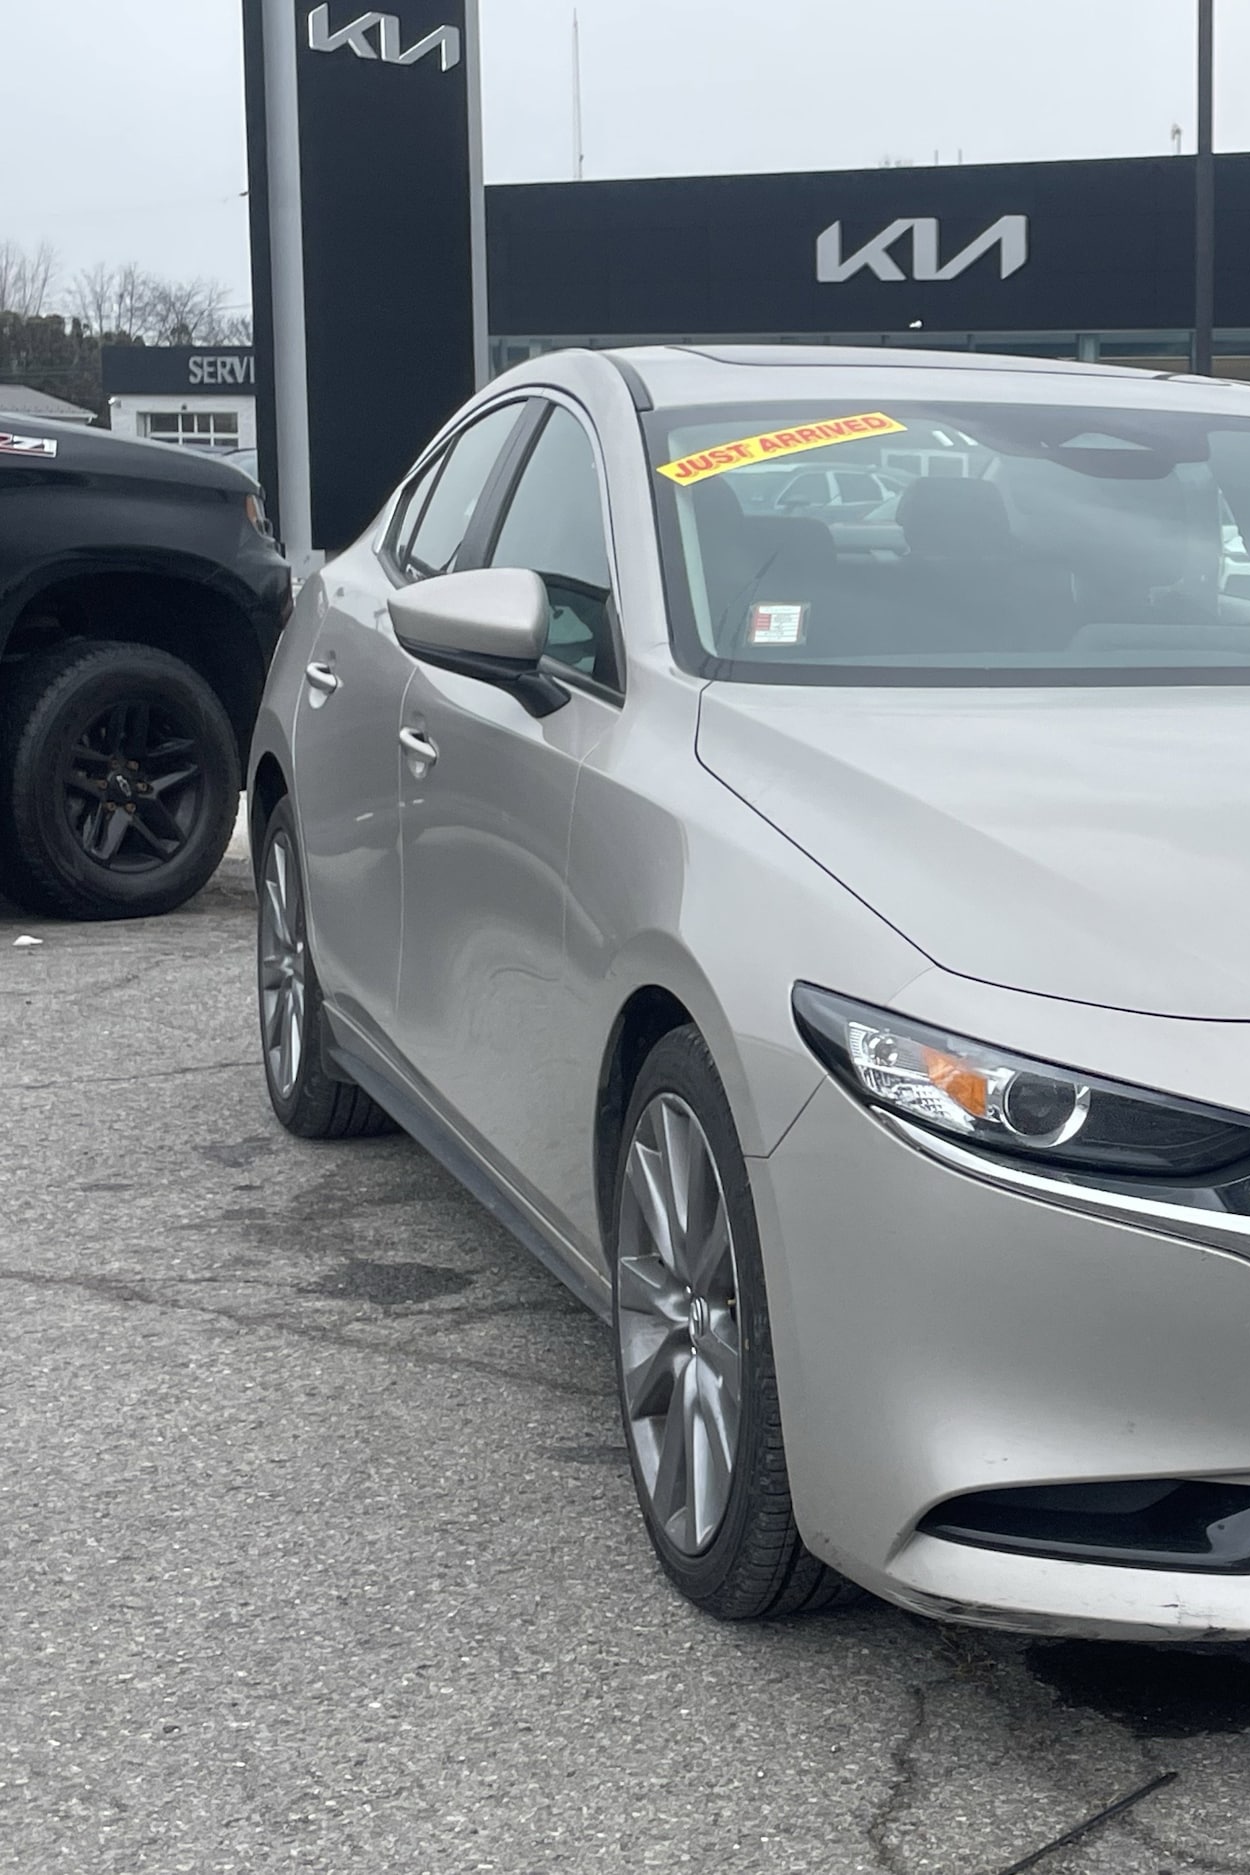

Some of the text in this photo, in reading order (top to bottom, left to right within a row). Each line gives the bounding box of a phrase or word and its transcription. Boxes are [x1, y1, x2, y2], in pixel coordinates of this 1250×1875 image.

[308, 2, 460, 72] KIA
[816, 215, 1029, 282] KIA
[675, 416, 890, 479] JUST ARRIVED
